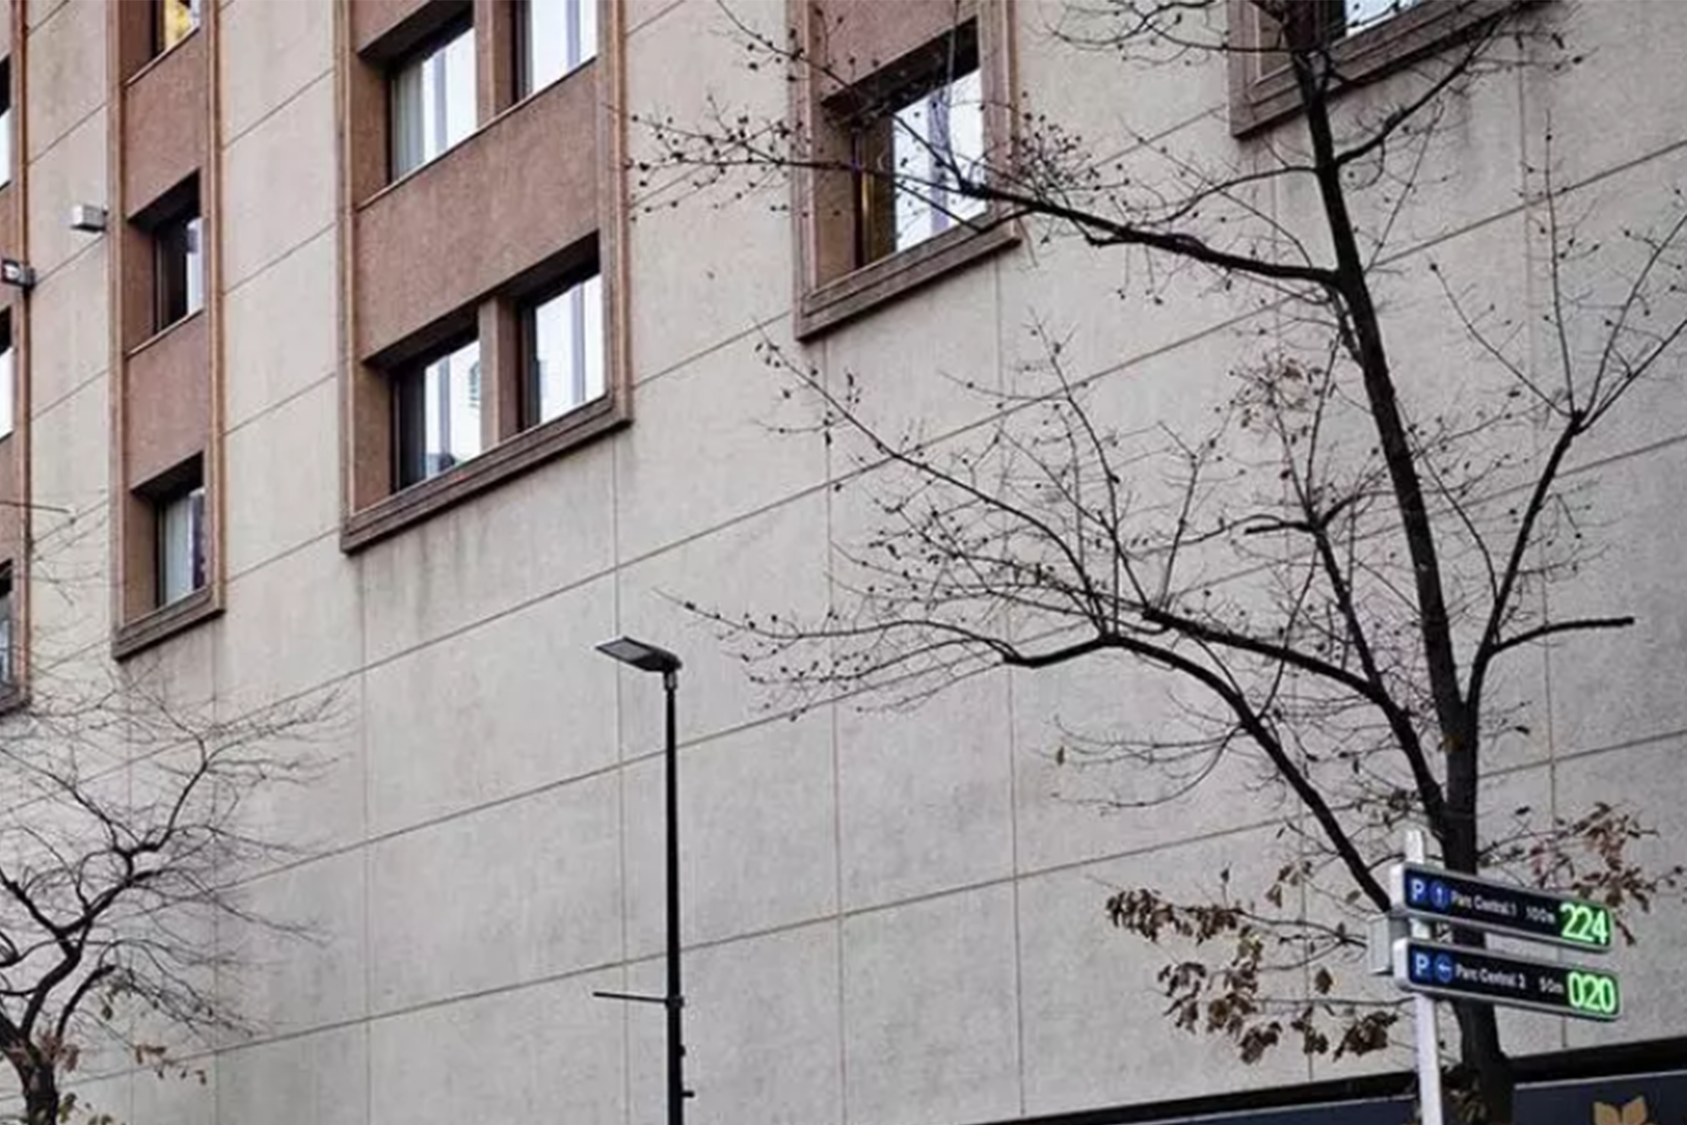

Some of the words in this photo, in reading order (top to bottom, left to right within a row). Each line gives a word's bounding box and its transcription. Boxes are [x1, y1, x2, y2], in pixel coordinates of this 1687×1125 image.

[1411, 879, 1425, 900] P
[1560, 902, 1608, 943] 224
[1416, 953, 1429, 975] P
[1455, 963, 1477, 980] Parc
[1567, 971, 1616, 1013] 020
